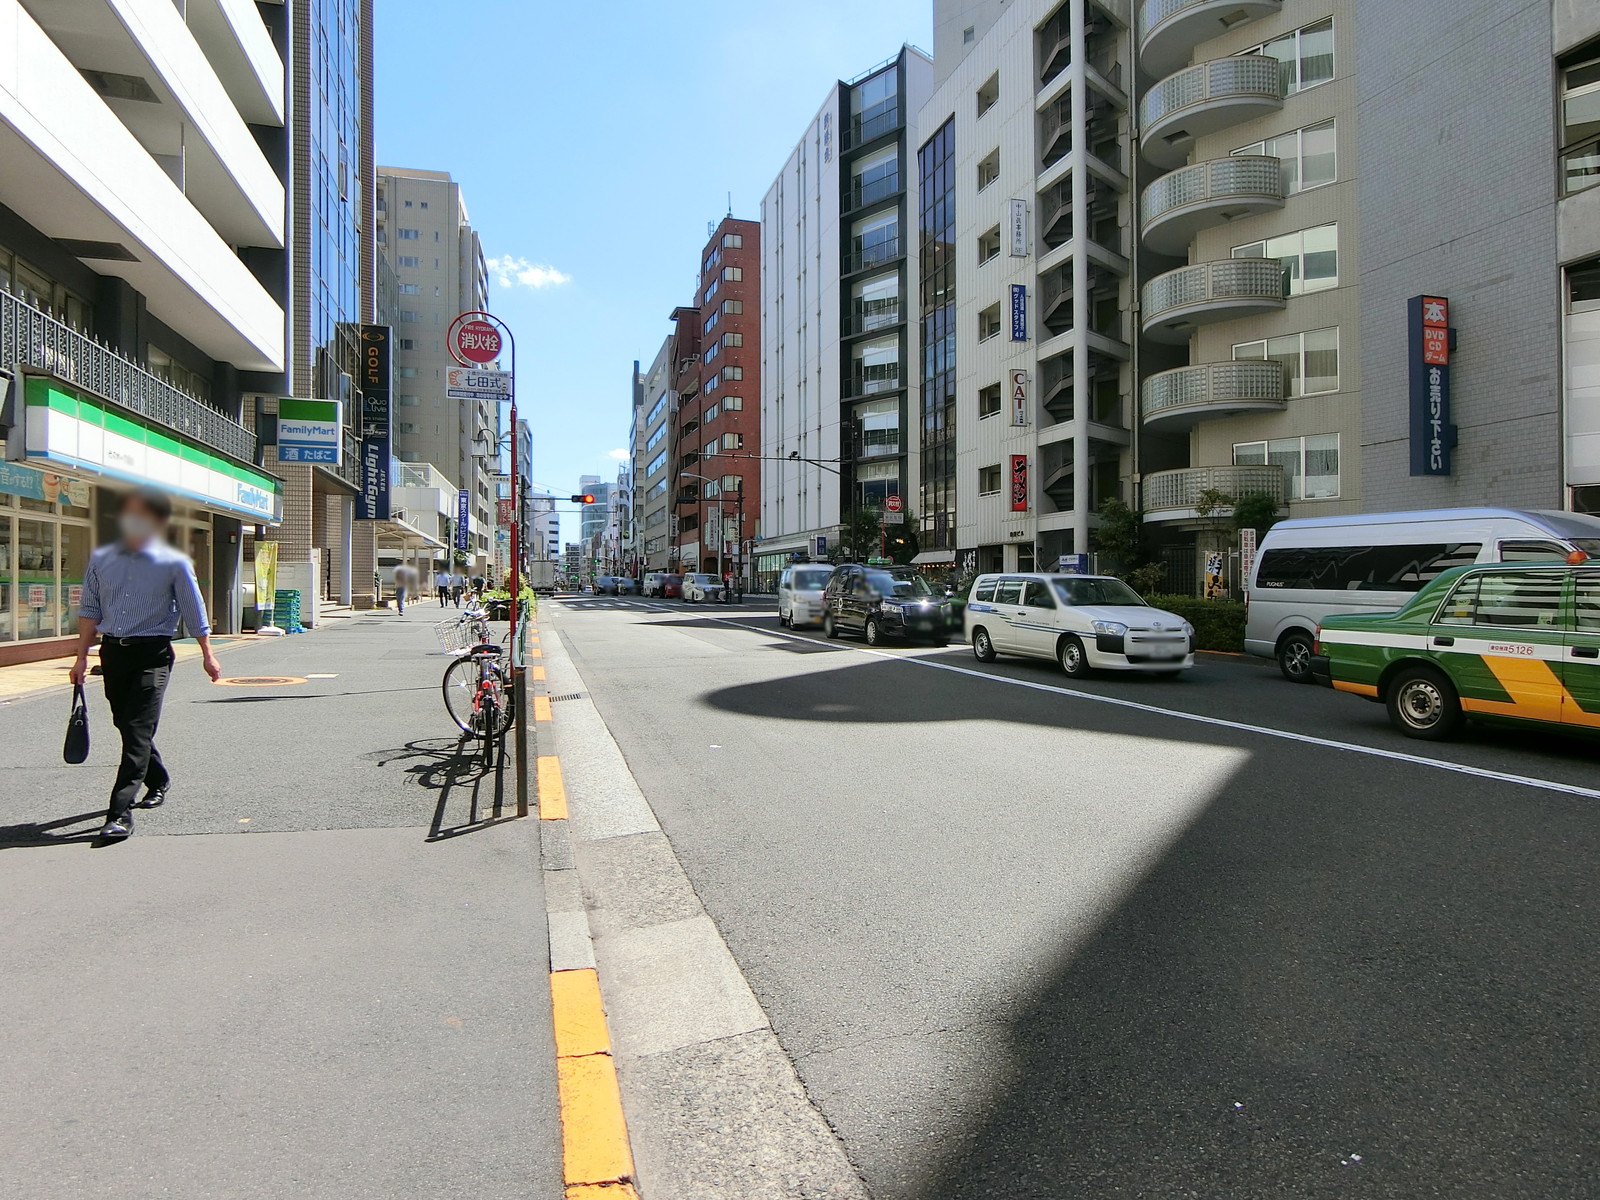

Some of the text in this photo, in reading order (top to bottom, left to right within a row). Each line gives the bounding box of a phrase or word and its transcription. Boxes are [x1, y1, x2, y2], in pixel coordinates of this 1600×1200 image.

[1424, 301, 1446, 322] 本
[462, 332, 499, 352] 消火栓
[1426, 329, 1445, 340] DVD
[1428, 341, 1442, 351] CD
[368, 346, 378, 384] GOLF
[1425, 352, 1446, 362] ゲーム
[465, 376, 502, 388] 七田式
[1014, 373, 1025, 409] CAT
[1429, 367, 1442, 471] お売り下さい
[281, 424, 335, 436] FamilyMart
[285, 448, 332, 460] 酒 たばこ
[366, 444, 379, 518] LightGym
